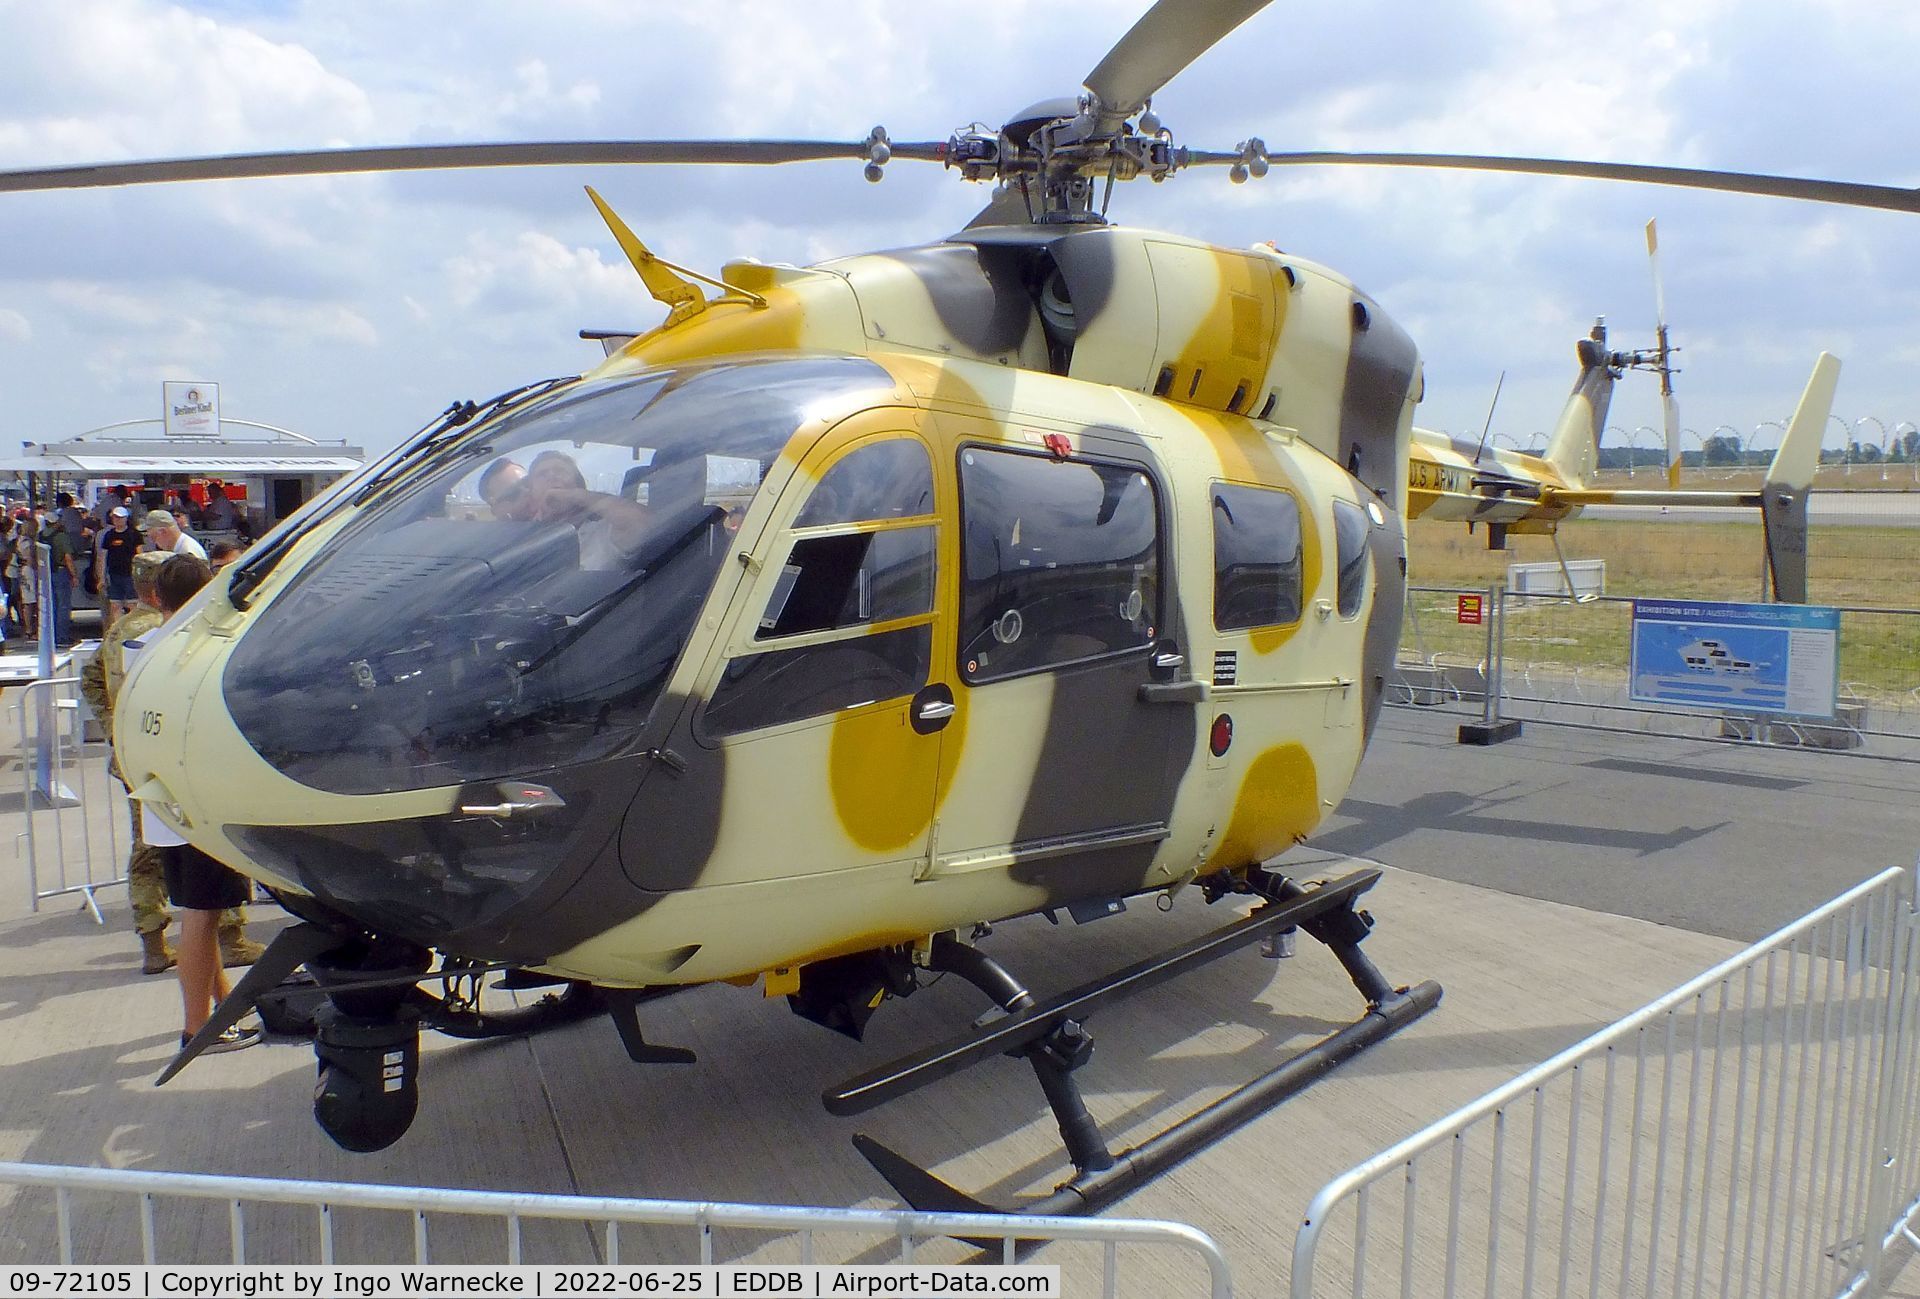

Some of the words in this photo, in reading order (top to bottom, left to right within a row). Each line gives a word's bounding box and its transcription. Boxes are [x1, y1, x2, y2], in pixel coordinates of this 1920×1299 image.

[1432, 467, 1460, 492] ARMY
[1636, 605, 1683, 616] EXHIBITION
[1683, 607, 1701, 616] SITE
[142, 710, 163, 736] 105
